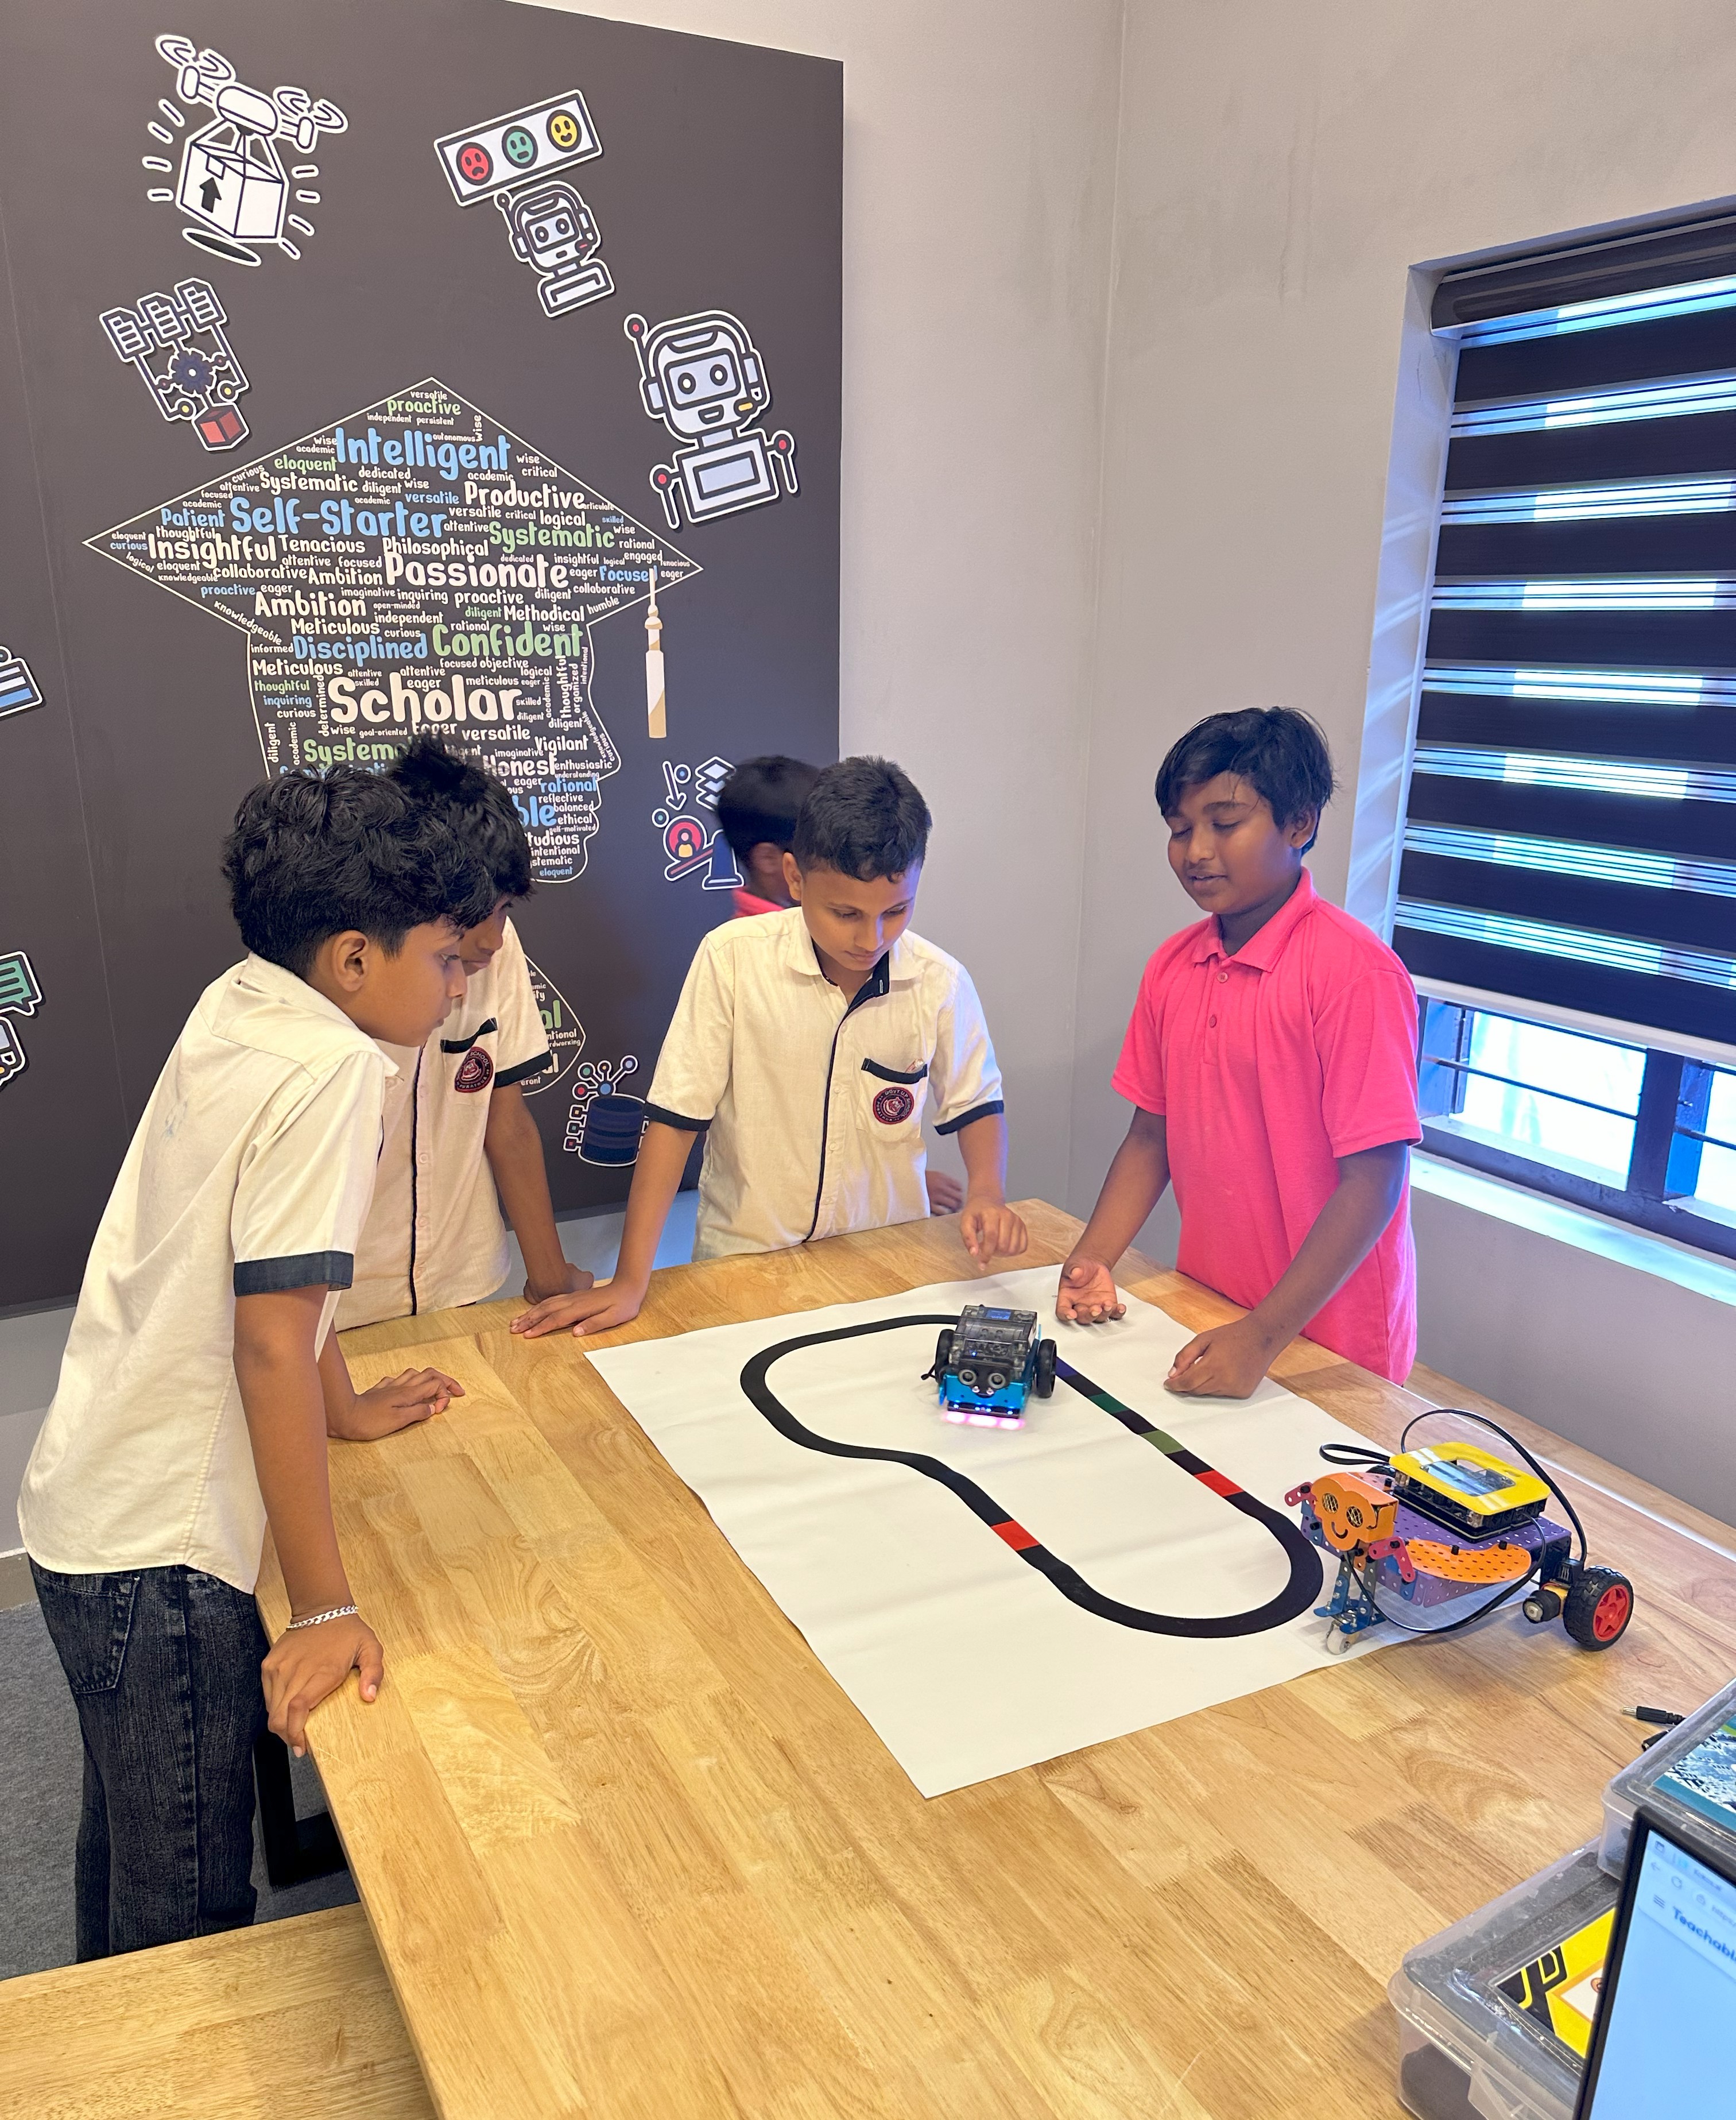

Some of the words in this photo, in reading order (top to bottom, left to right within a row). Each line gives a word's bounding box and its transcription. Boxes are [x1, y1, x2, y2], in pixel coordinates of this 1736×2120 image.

[410, 390, 447, 400] versatile
[387, 399, 461, 415] proactive
[367, 413, 412, 424] independent
[417, 417, 454, 425] persistent
[473, 415, 482, 442] wise
[314, 435, 337, 445] wise
[433, 433, 475, 442] autonomous
[296, 444, 335, 454] academic
[336, 427, 511, 481] Intelligent
[517, 453, 540, 463] wise
[274, 455, 337, 475] eloquent
[232, 465, 265, 483] curious
[359, 466, 410, 479] dedicated
[468, 470, 514, 481] academic
[522, 466, 557, 478] critical
[220, 483, 259, 492] attentive
[259, 472, 358, 495] Systematic
[362, 482, 402, 496] diligent
[404, 478, 429, 489] wise
[202, 490, 233, 498] focused
[355, 496, 390, 505] academic
[405, 491, 459, 504] versatile
[464, 480, 585, 509] Productive
[183, 499, 222, 508] academic
[582, 502, 615, 510] articulate
[161, 508, 225, 527] Patient
[230, 495, 447, 538] Self-Starter
[449, 505, 501, 518] versatile
[506, 510, 536, 520] critical
[540, 509, 586, 529] logical
[602, 516, 624, 524] skilled
[444, 520, 489, 532] attentive
[613, 524, 636, 534] wise
[112, 532, 146, 541] eloquent
[156, 526, 215, 541] thoughtful
[489, 521, 615, 554] Systematic
[110, 541, 148, 550] curious
[278, 535, 365, 553] Tenacious
[383, 536, 489, 561] Philosophical
[619, 539, 655, 550] rational
[148, 533, 276, 569] Insightful
[624, 550, 662, 564] engaged
[126, 552, 154, 573] logical
[281, 554, 331, 566] attentive
[338, 556, 382, 568] focused
[501, 554, 534, 563] dedicated
[554, 553, 599, 567] insightful
[604, 558, 625, 566] logical
[157, 560, 200, 574] eloquent
[213, 564, 307, 579] collaborative
[384, 551, 569, 588] Passionate
[569, 567, 598, 580] eager
[158, 574, 218, 584] knowledgeable
[308, 567, 382, 585] Ambition
[661, 570, 683, 581] eager
[202, 584, 255, 598] proactive
[261, 584, 293, 596] eager
[341, 587, 395, 598] imaginative
[535, 587, 571, 602] diligent
[574, 583, 636, 595] collaborative
[397, 589, 448, 603] inquiring
[455, 589, 524, 608] proactive
[255, 590, 366, 617] Ambition
[373, 602, 420, 611] open-minded
[587, 596, 619, 614] humble
[374, 611, 443, 626] independent
[465, 606, 502, 620] diligent
[504, 604, 584, 622] Methodical
[214, 601, 282, 645] knowledgeable
[291, 618, 380, 635] Meticulous
[451, 621, 489, 631] rational
[543, 622, 565, 632] wise
[384, 629, 421, 637] curious
[433, 621, 583, 657] Confident
[251, 643, 294, 653] informed
[293, 633, 428, 667] Disciplined
[253, 659, 343, 675] Meticulous
[440, 659, 477, 668] focused
[480, 657, 529, 672] objective
[348, 669, 382, 678] attentive
[400, 666, 445, 676] attentive
[521, 666, 552, 679] logical
[254, 680, 309, 694] thoughtful
[355, 678, 379, 686] skilled
[407, 679, 441, 692] eager
[466, 675, 518, 686] meticulous
[521, 679, 540, 687] eager
[555, 655, 572, 718] thoughtful
[569, 663, 583, 713] organized
[263, 695, 312, 708] inquiring
[328, 672, 522, 723] Scholar
[516, 697, 541, 705] skilled
[542, 676, 551, 718] academic
[313, 674, 329, 737] determined
[277, 708, 316, 718] curious
[517, 712, 544, 722] diligent
[331, 725, 355, 735] wise
[549, 717, 583, 731] diligent
[359, 728, 407, 738] goal-oriented
[462, 725, 530, 741] versatile
[582, 711, 606, 759] knowledgeable
[265, 722, 280, 763] diligent
[288, 722, 300, 765] academic
[534, 735, 588, 755] Vigilant
[599, 733, 615, 761] curious
[495, 748, 544, 759] imaginative
[482, 752, 557, 777] Honest
[555, 760, 613, 769] enthusiastic
[514, 777, 542, 789] eager
[540, 776, 598, 793] rational
[538, 794, 583, 804] reflective
[553, 800, 594, 812] balanced
[557, 813, 592, 825] ethical
[549, 824, 596, 835] self-motivated
[525, 830, 579, 846] tudious
[531, 845, 580, 856] intentional
[530, 856, 573, 868] stematic
[540, 866, 573, 878] eloquent
